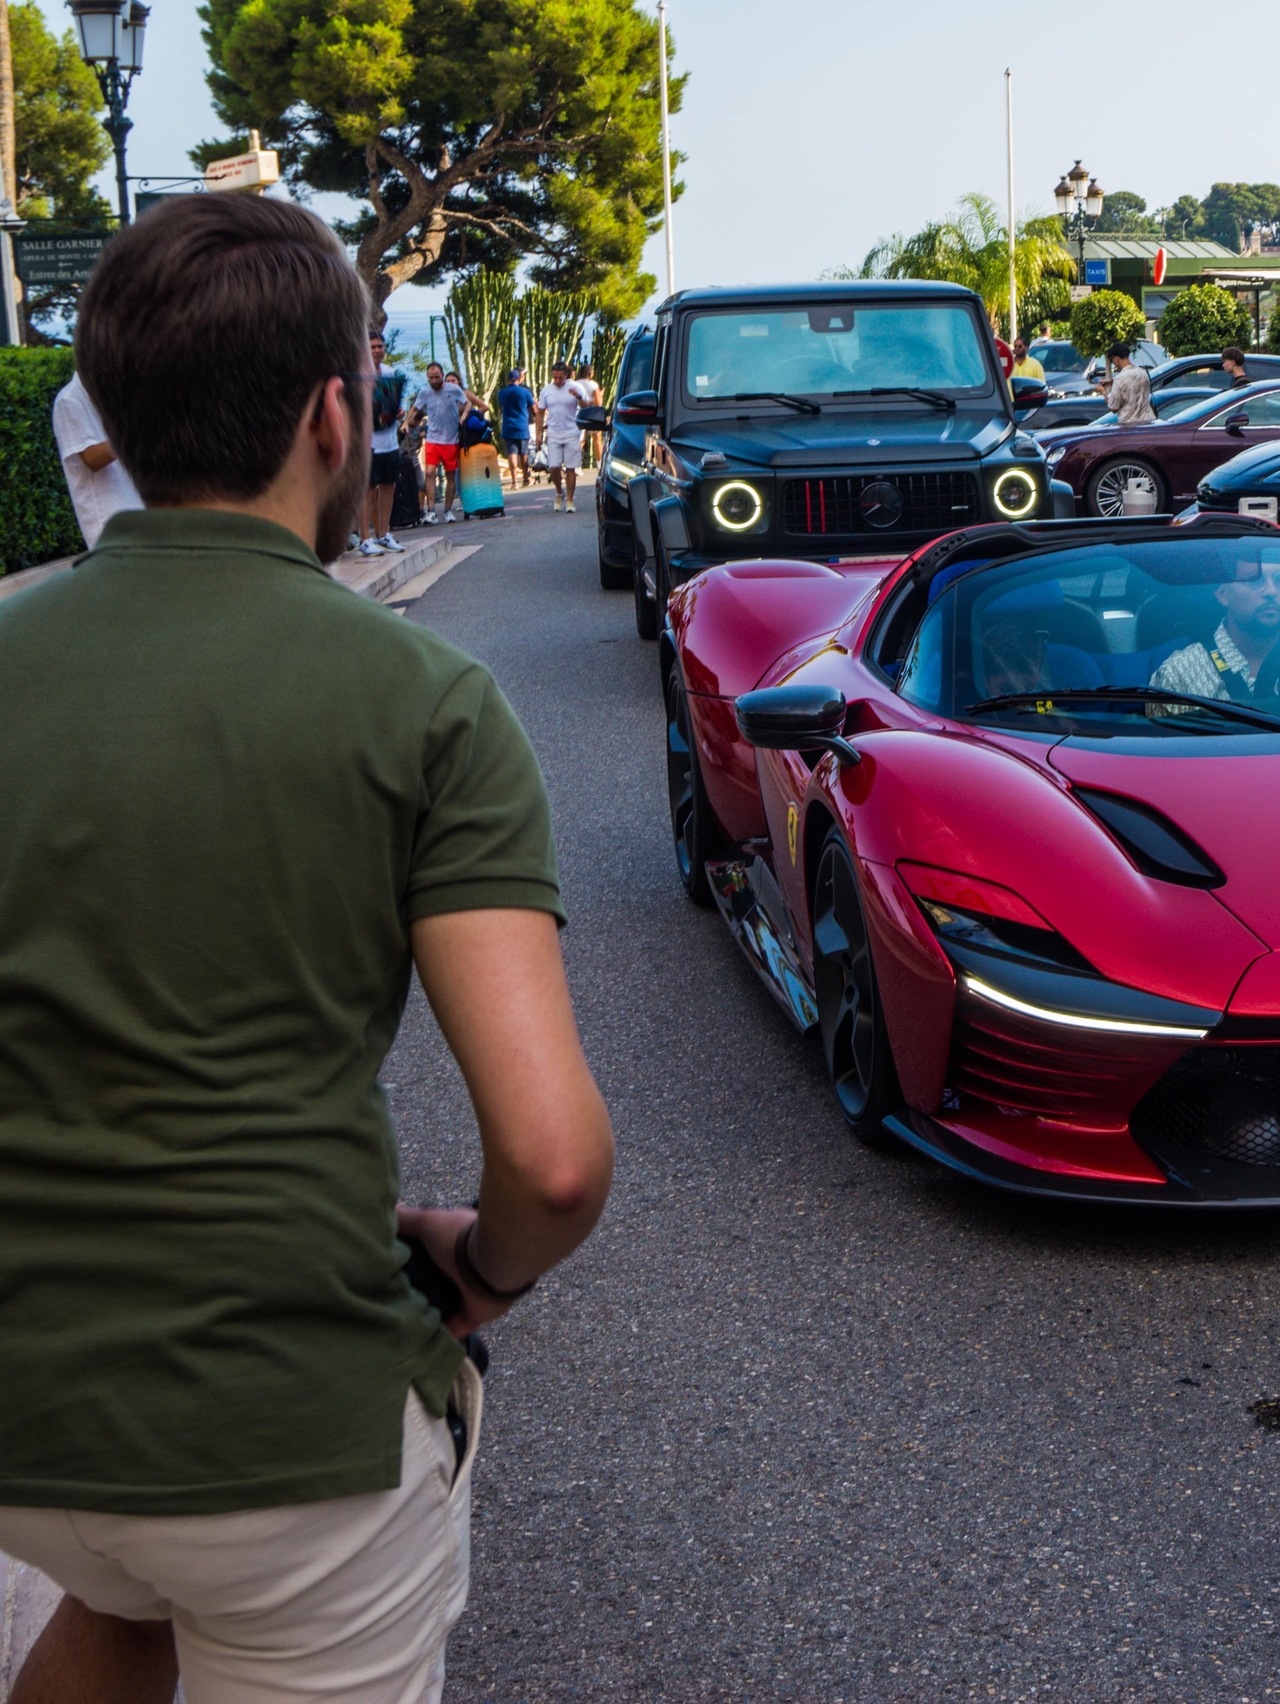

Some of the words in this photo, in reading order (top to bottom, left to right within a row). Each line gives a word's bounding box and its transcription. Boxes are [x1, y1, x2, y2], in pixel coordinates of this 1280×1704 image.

[22, 241, 54, 250] SALLE
[56, 239, 103, 249] GARNIER
[57, 270, 71, 279] des
